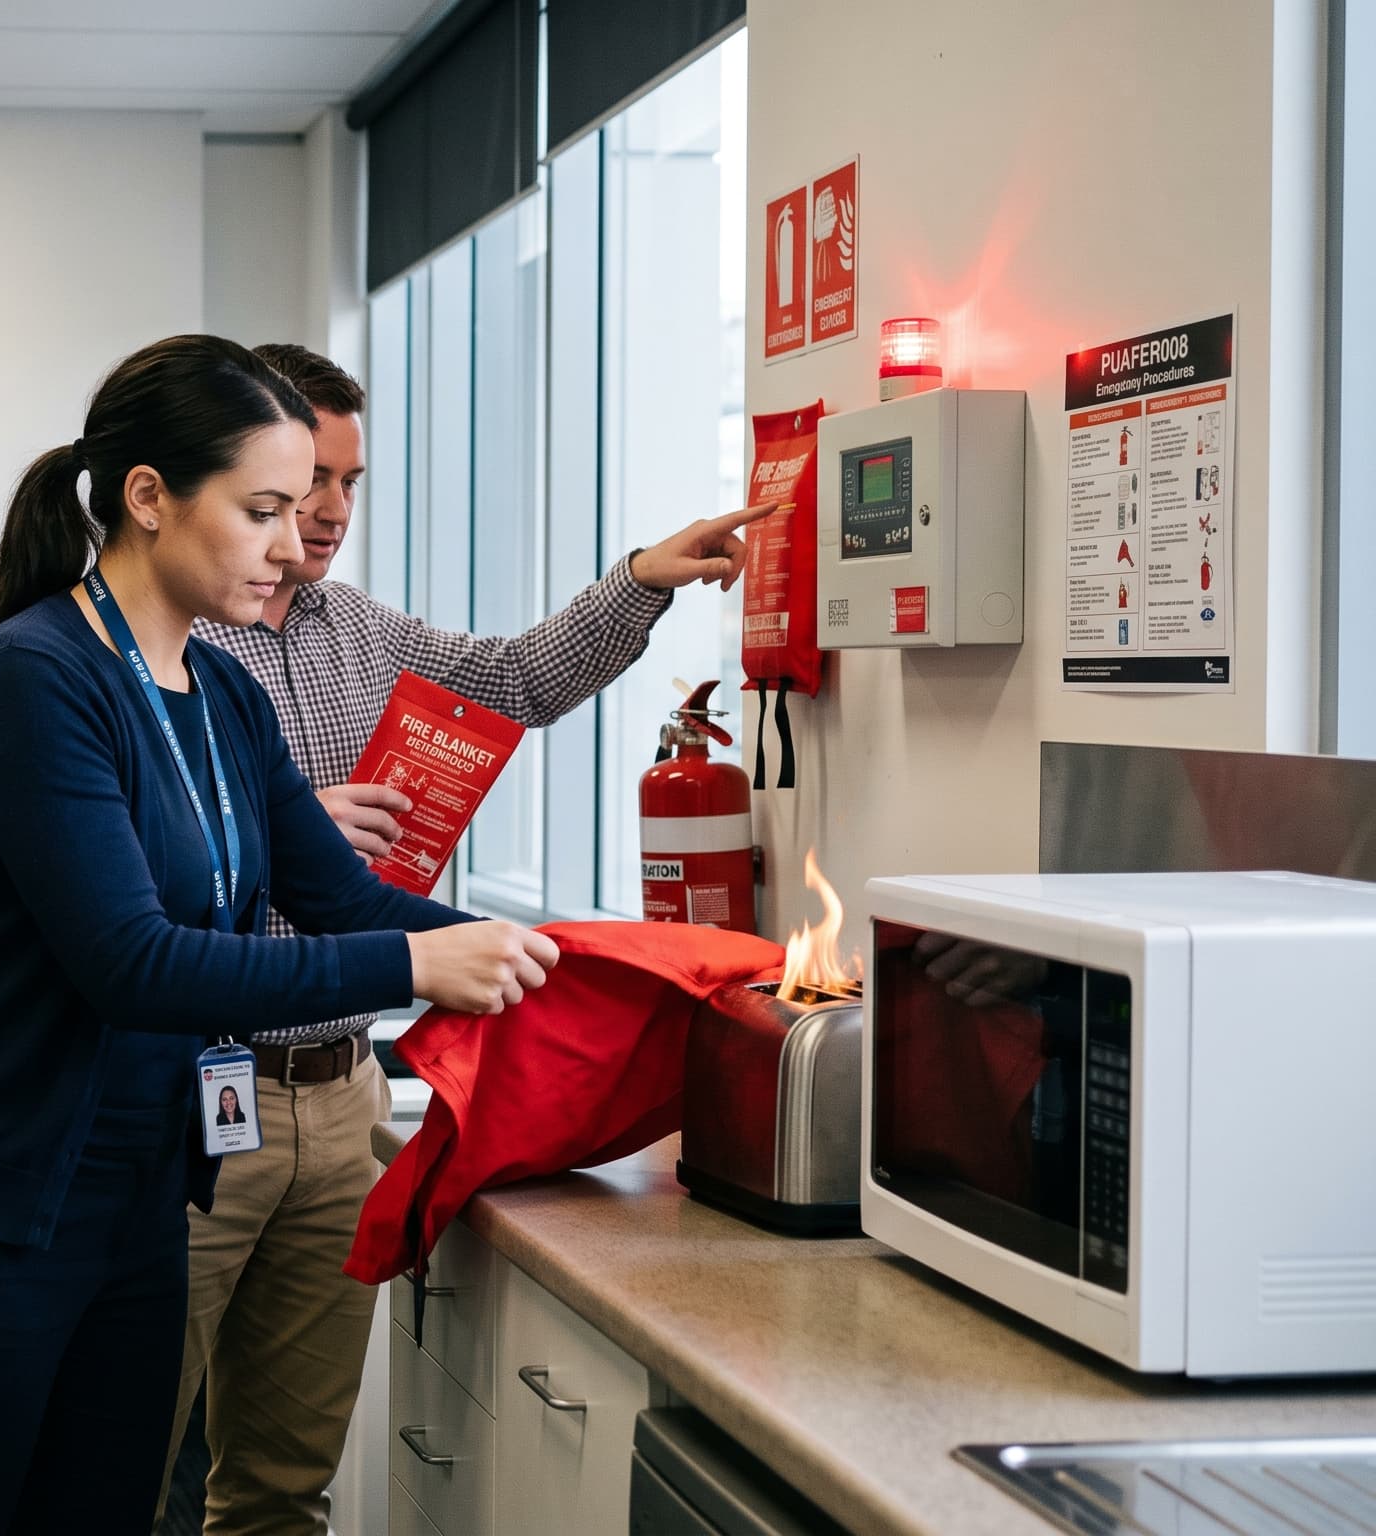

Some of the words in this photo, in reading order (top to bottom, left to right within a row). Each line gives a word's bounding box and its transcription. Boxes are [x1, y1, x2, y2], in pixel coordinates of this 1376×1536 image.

[1101, 333, 1189, 376] PUAFER008
[400, 713, 432, 740] FIRE
[432, 729, 496, 768] BLANKET
